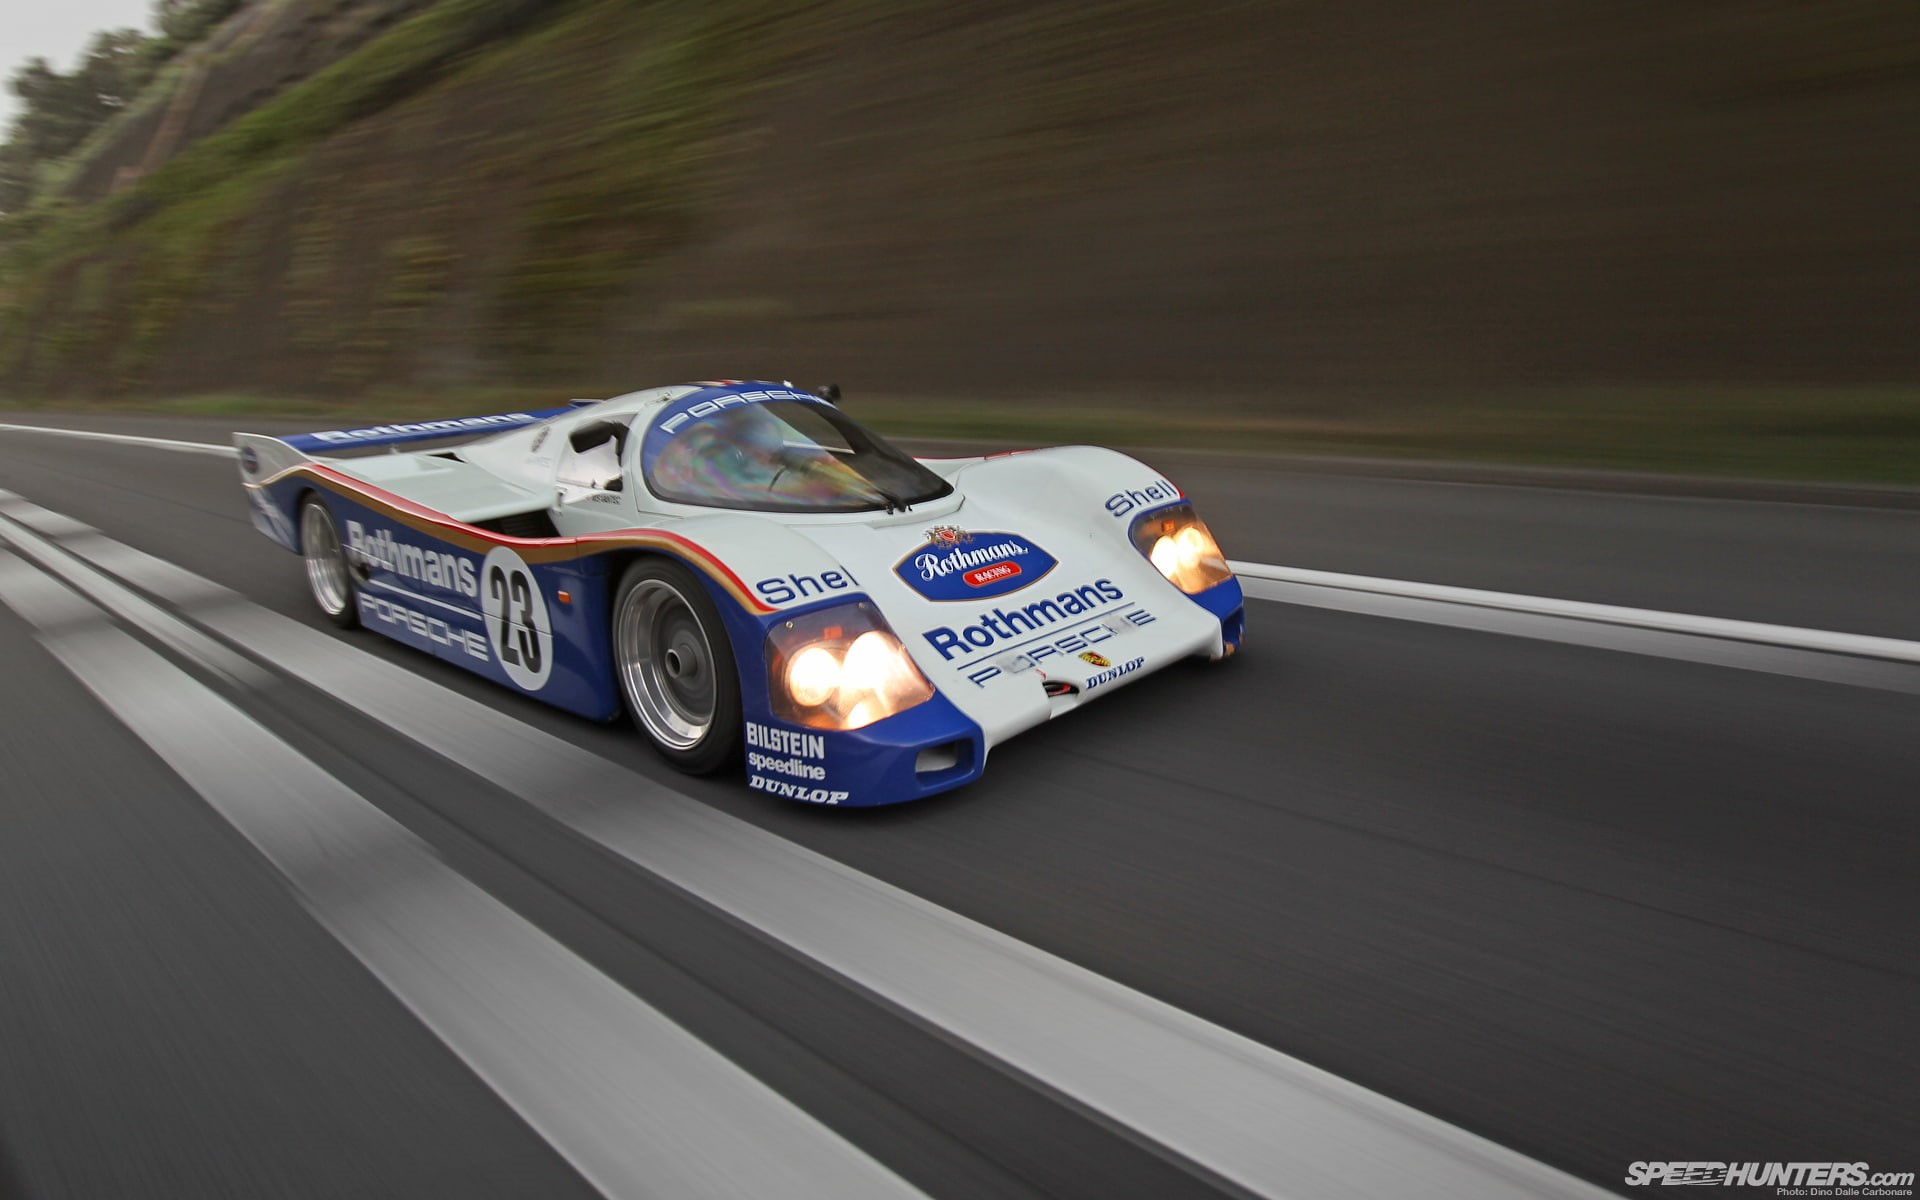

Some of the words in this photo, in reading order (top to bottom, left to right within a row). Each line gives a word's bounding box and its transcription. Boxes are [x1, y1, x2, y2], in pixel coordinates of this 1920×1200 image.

[310, 413, 536, 444] Rothmans
[1105, 480, 1178, 517] Shell
[346, 519, 478, 598] Rothmans
[974, 564, 1012, 583] RACING
[358, 591, 489, 662] PORSCHE
[489, 565, 542, 673] 23
[921, 577, 1124, 662] Rothmans
[1085, 656, 1145, 690] DUNLOP
[746, 721, 825, 760] BILSTEIN
[748, 752, 826, 781] speedline
[750, 774, 849, 805] DUNLOP
